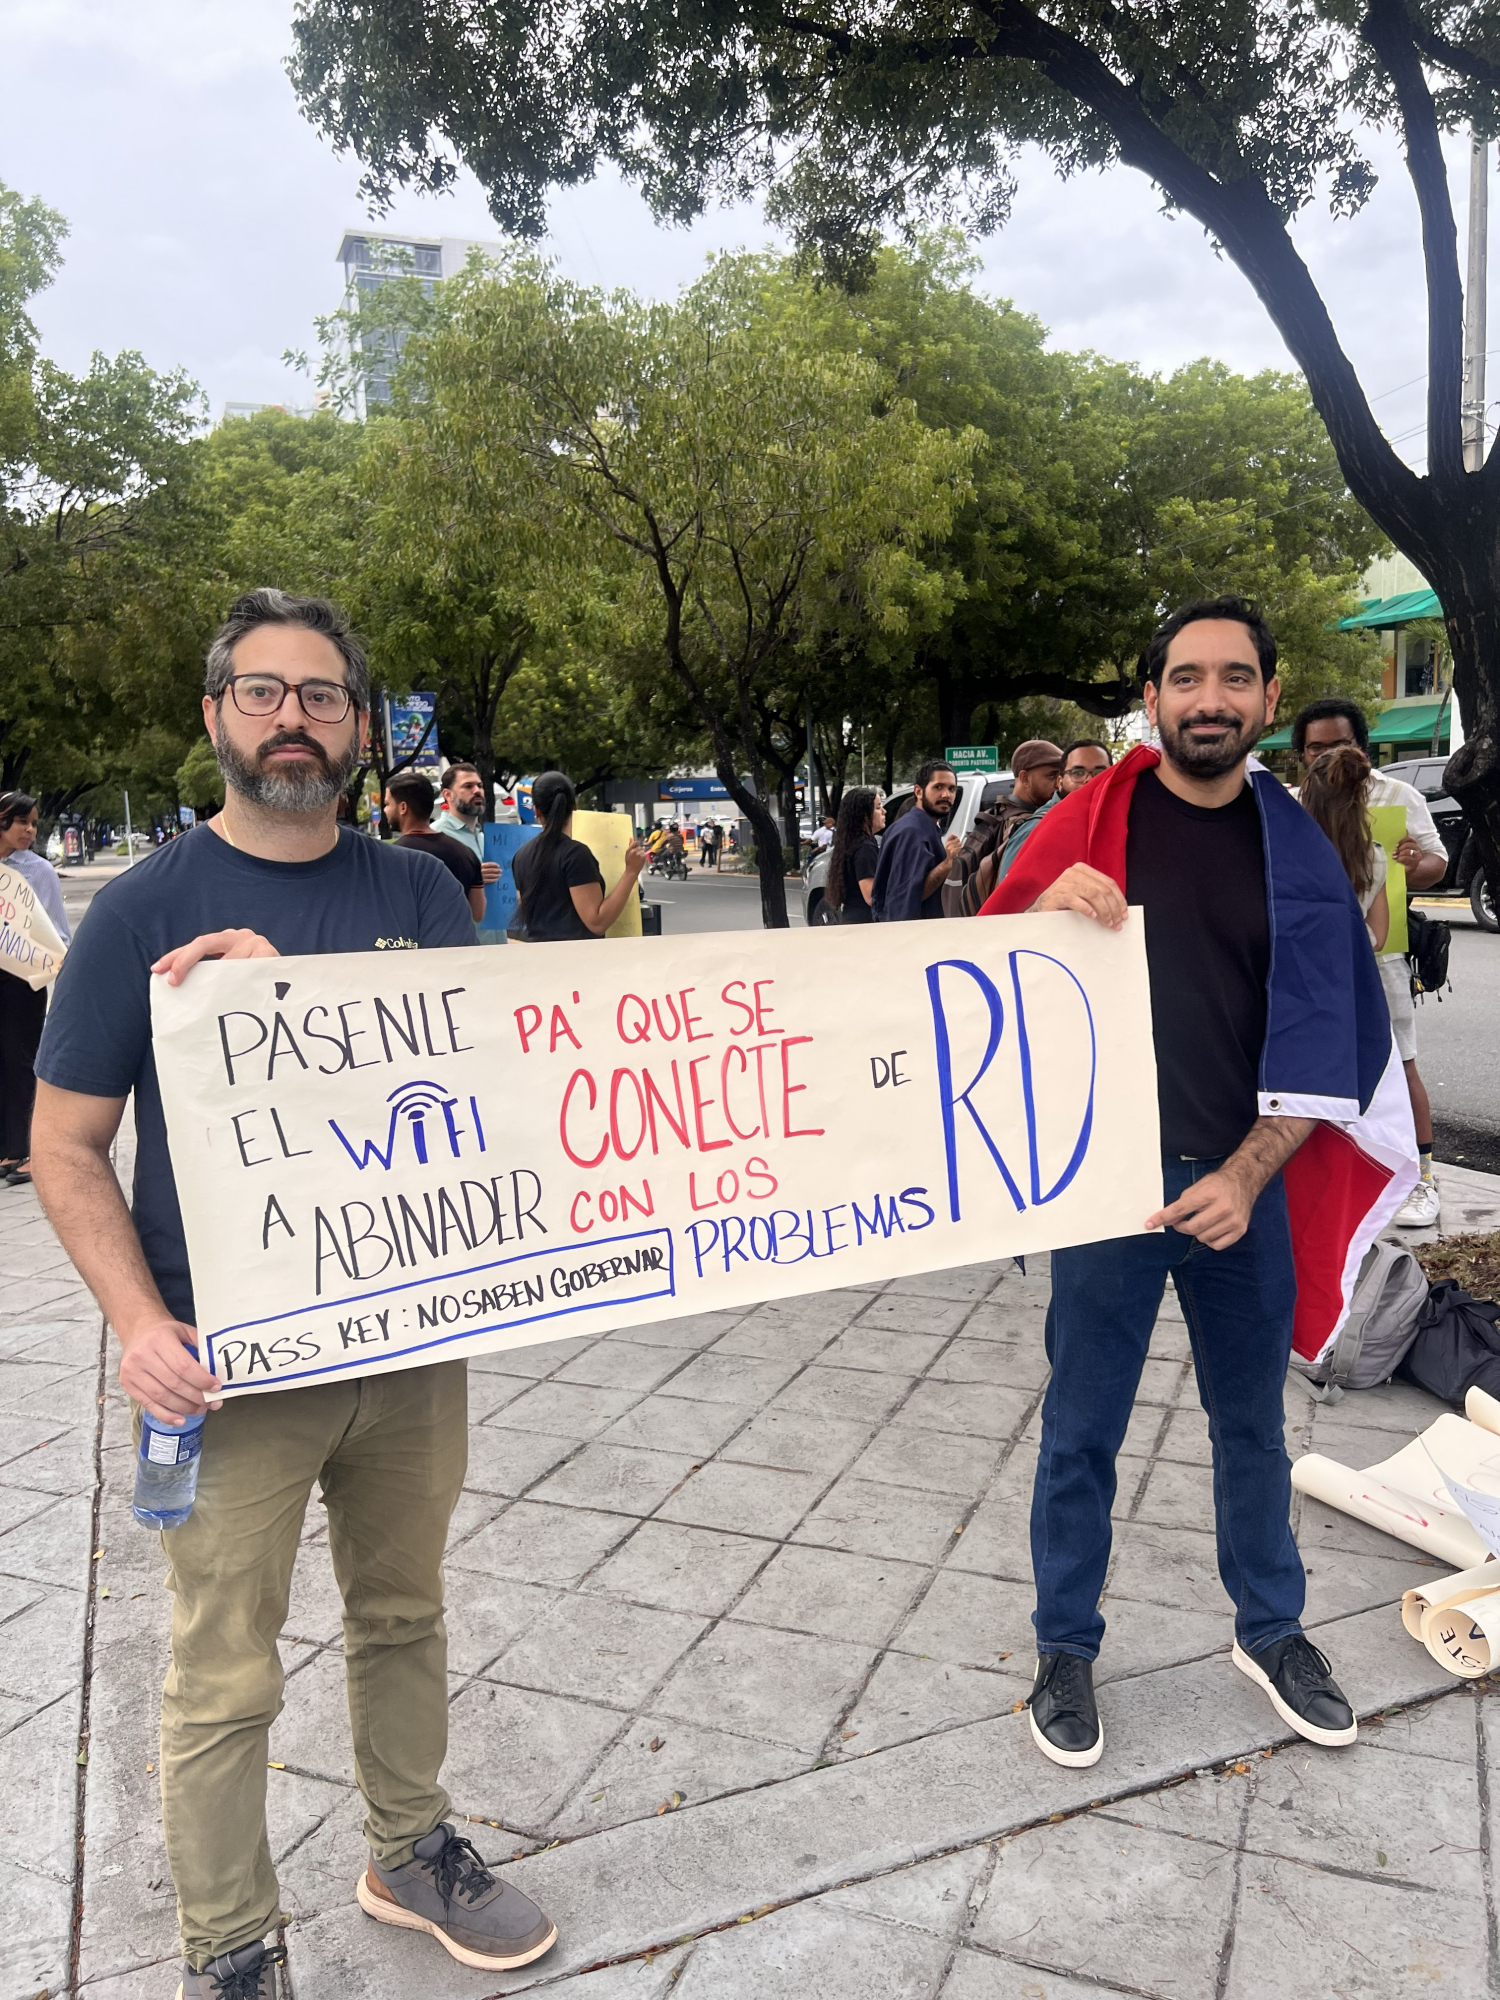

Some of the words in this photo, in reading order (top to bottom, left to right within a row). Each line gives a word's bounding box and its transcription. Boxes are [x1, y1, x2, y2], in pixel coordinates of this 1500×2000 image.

[953, 750, 975, 759] HACIA
[976, 749, 988, 758] AV.
[218, 982, 475, 1085] PÁSENLE
[514, 990, 583, 1054] PA'
[616, 987, 714, 1044] QUE
[722, 979, 786, 1037] SE
[559, 1035, 826, 1169] CONECTE
[869, 1050, 912, 1089] DE
[924, 949, 1096, 1223] RD
[231, 1107, 313, 1168] EL
[263, 1193, 296, 1251] A
[315, 1169, 548, 1296] ABINADER
[570, 1178, 655, 1234] CON
[689, 1156, 778, 1212] LOS
[684, 1186, 935, 1278] PROBLEMAS
[217, 1331, 321, 1381] PASS
